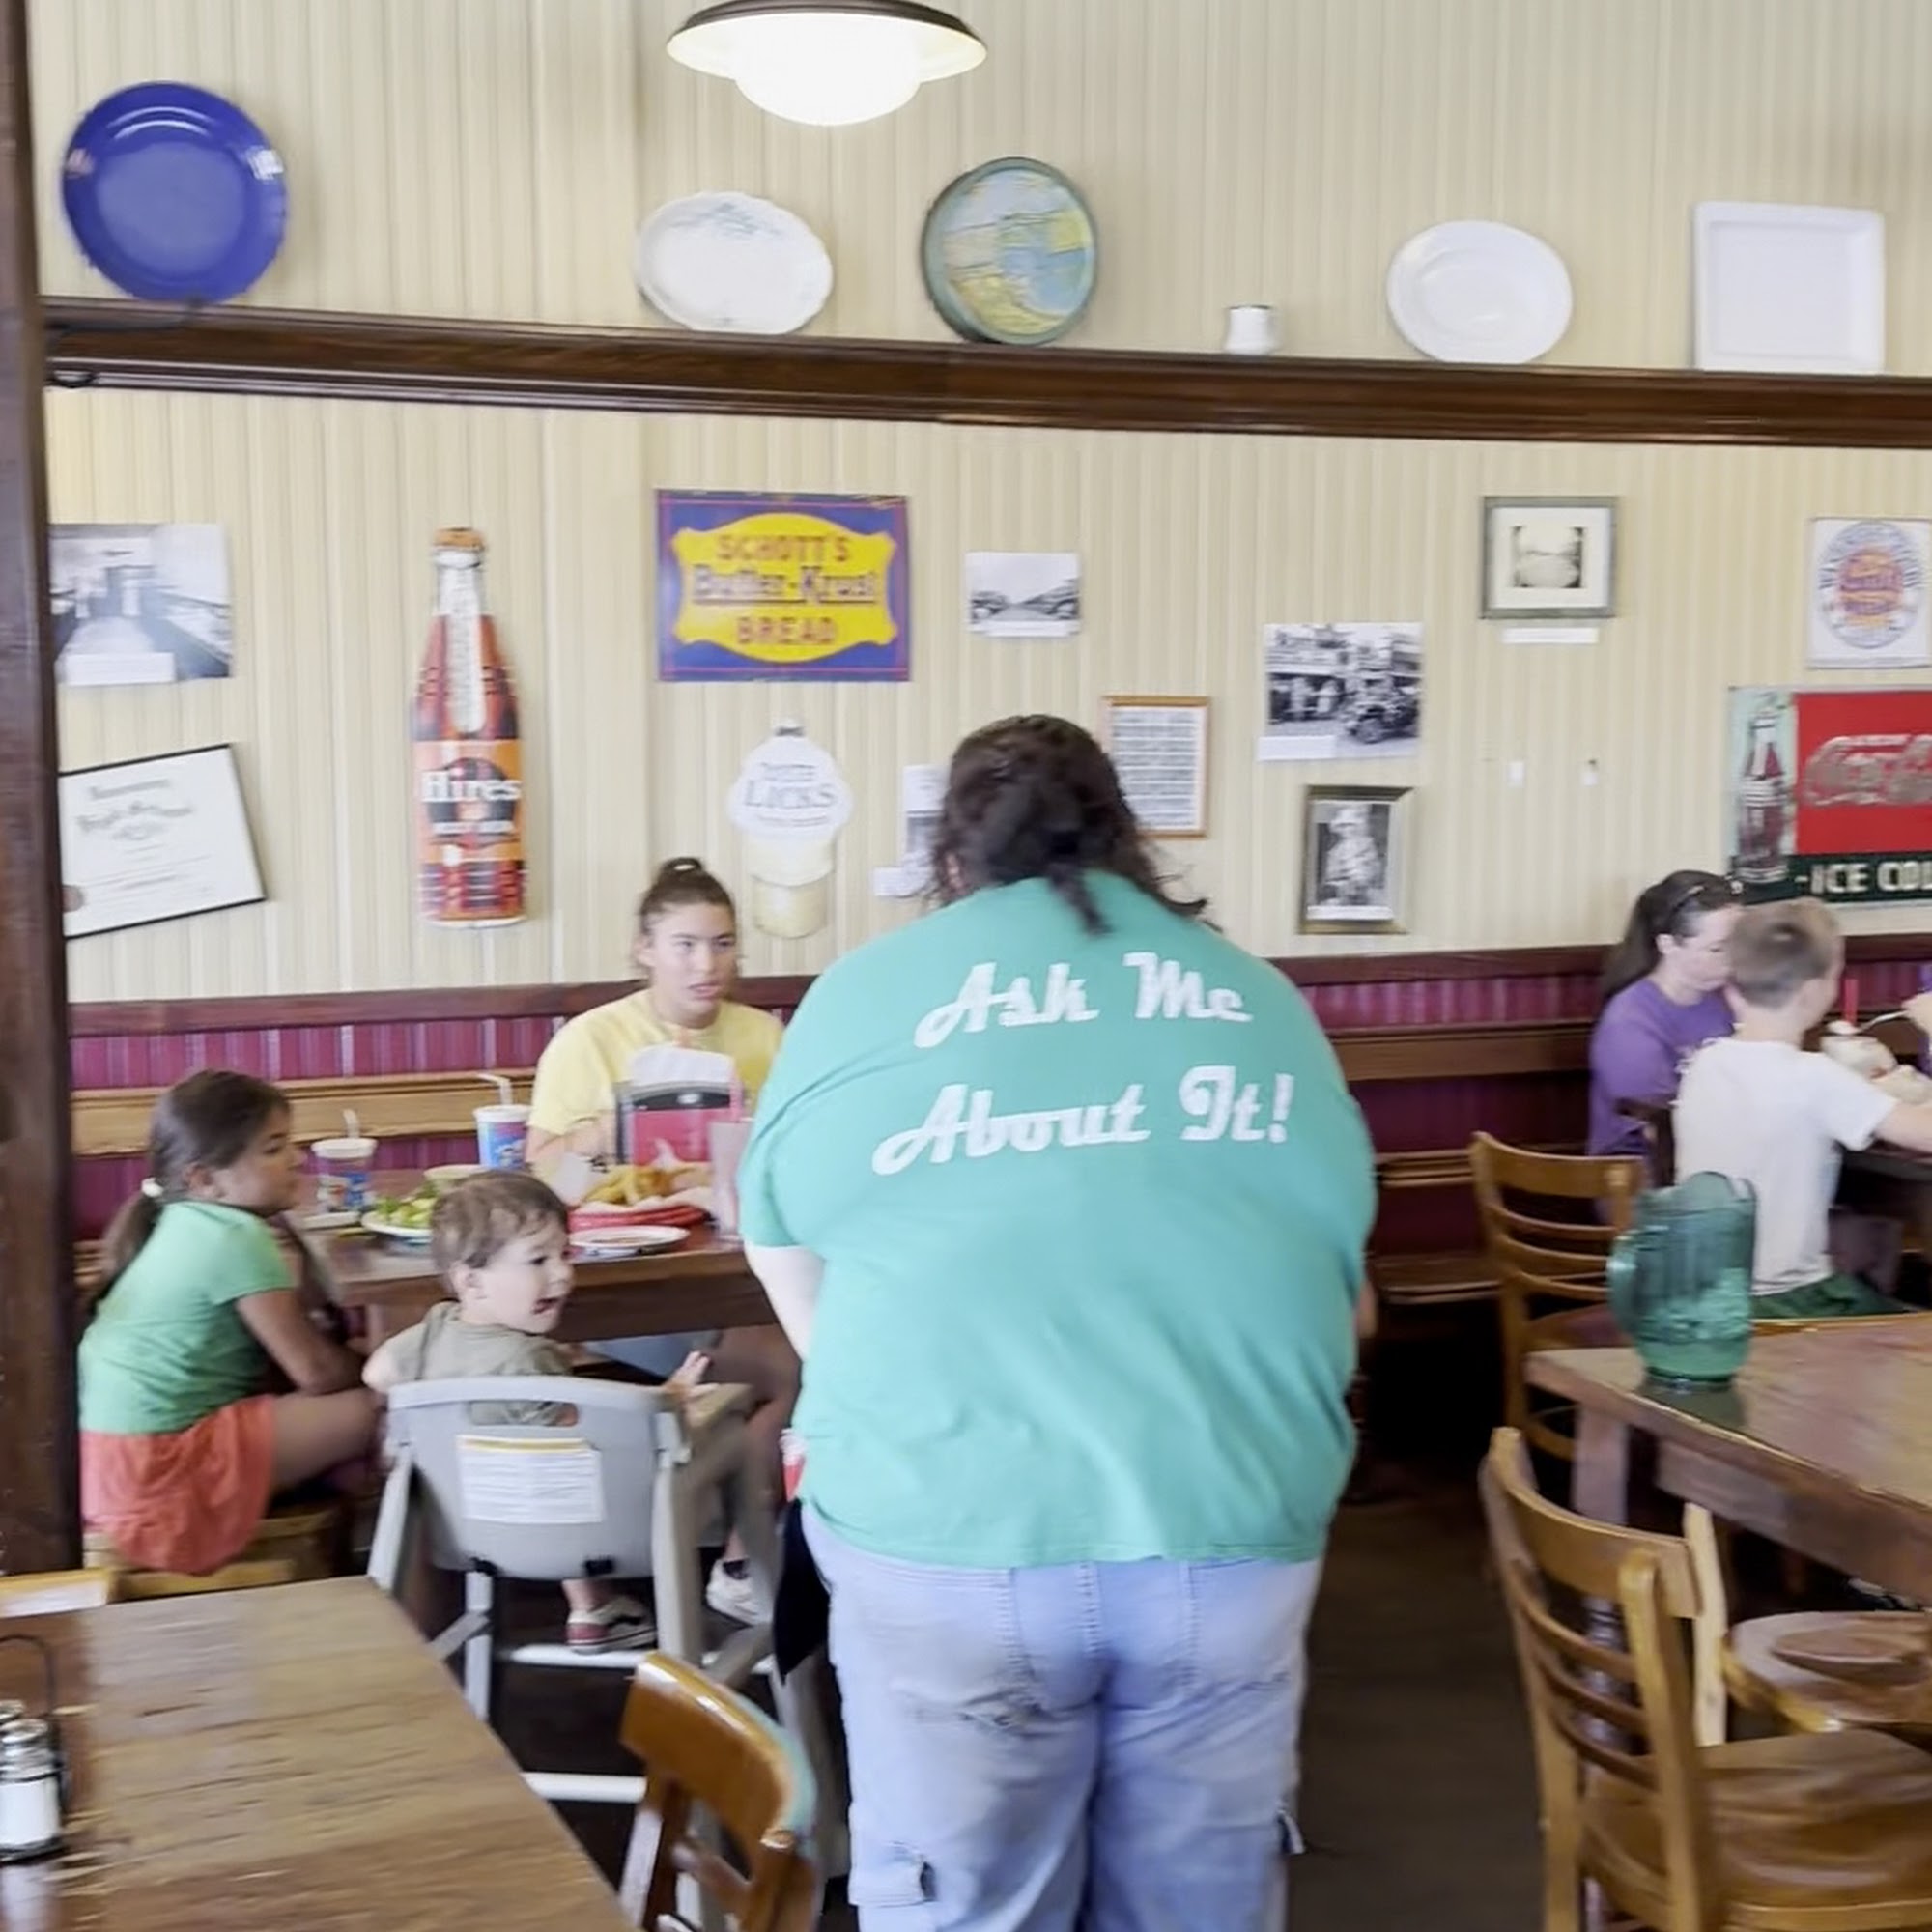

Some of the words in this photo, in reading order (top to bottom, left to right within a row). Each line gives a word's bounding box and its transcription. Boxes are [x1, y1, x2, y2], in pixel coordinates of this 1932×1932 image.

[735, 615, 839, 646] BREAD
[913, 961, 1100, 1049] Ask
[1122, 951, 1254, 1024] Me
[871, 1082, 1151, 1177] About
[1179, 1065, 1295, 1145] It!
